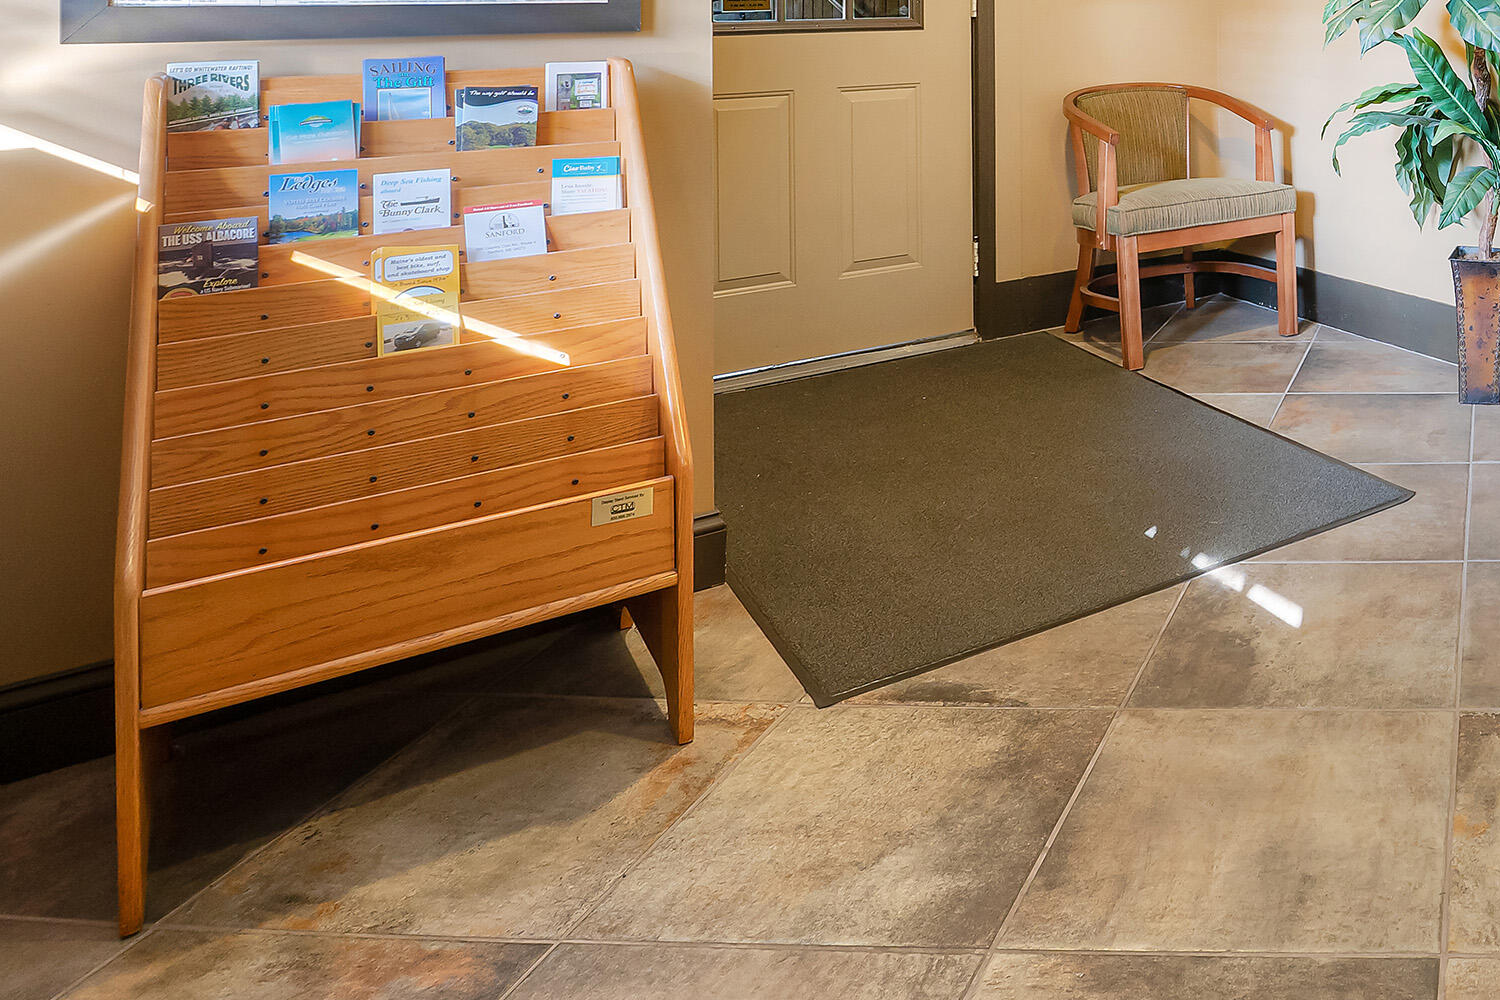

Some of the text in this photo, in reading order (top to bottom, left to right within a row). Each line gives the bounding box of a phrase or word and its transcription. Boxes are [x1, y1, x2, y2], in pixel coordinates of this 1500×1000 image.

[370, 62, 436, 76] SAILING
[172, 73, 250, 95] THREE RIVERS
[374, 75, 435, 89] The Gift
[279, 174, 338, 193] Ledges
[379, 205, 444, 217] Bunny Clark
[380, 200, 398, 209] The
[174, 220, 251, 234] Welcome Aboard
[485, 228, 525, 238] SANFORD
[162, 228, 255, 247] THE USS ALBACORE
[203, 278, 238, 288] Explore
